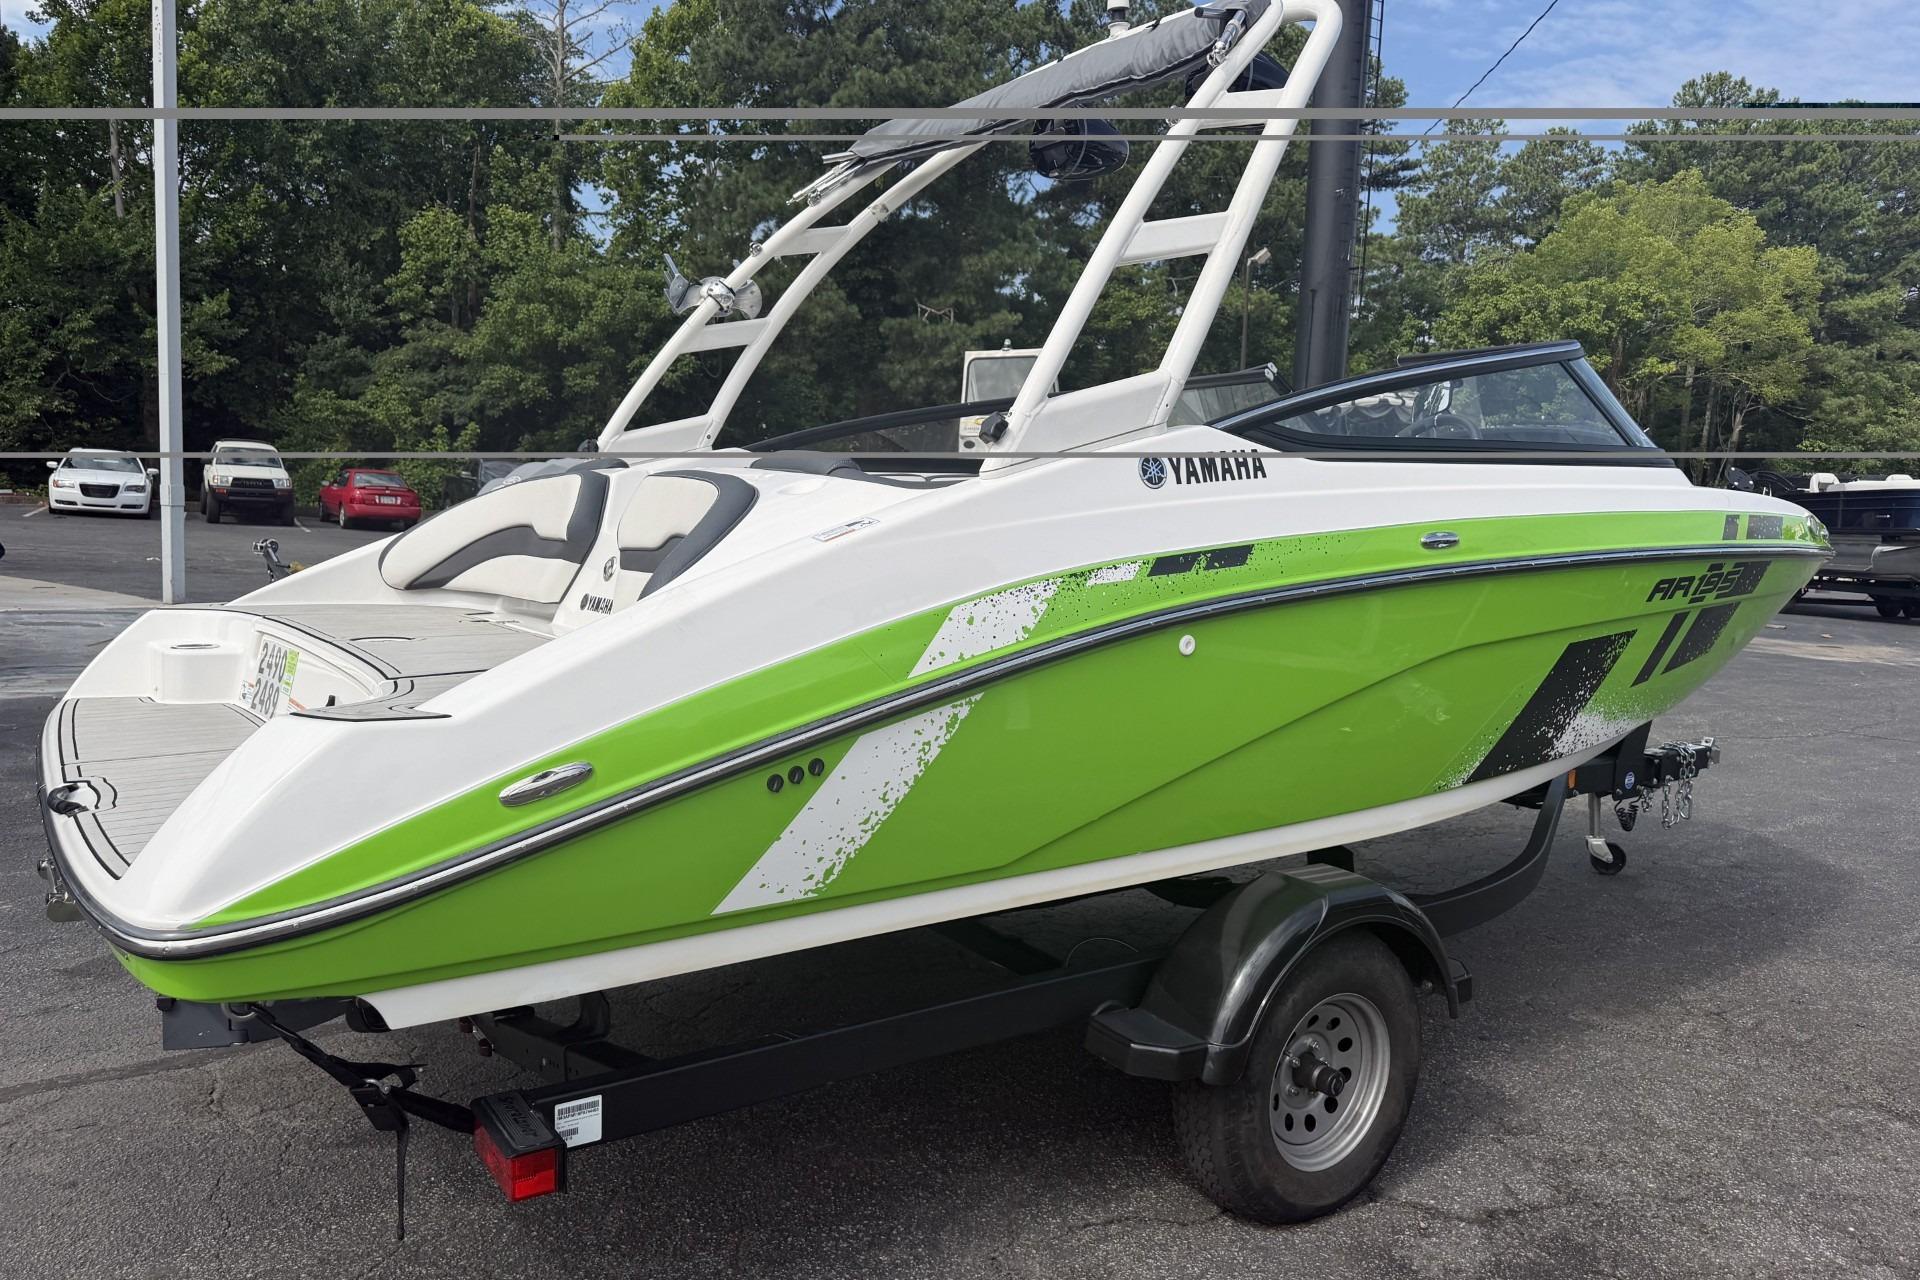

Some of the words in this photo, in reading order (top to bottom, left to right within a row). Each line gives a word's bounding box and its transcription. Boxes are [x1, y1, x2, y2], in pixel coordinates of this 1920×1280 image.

[1167, 449, 1267, 485] YAMAHA
[587, 595, 614, 615] YAMAHA
[258, 642, 287, 682] 2490
[250, 677, 280, 719] 2489
